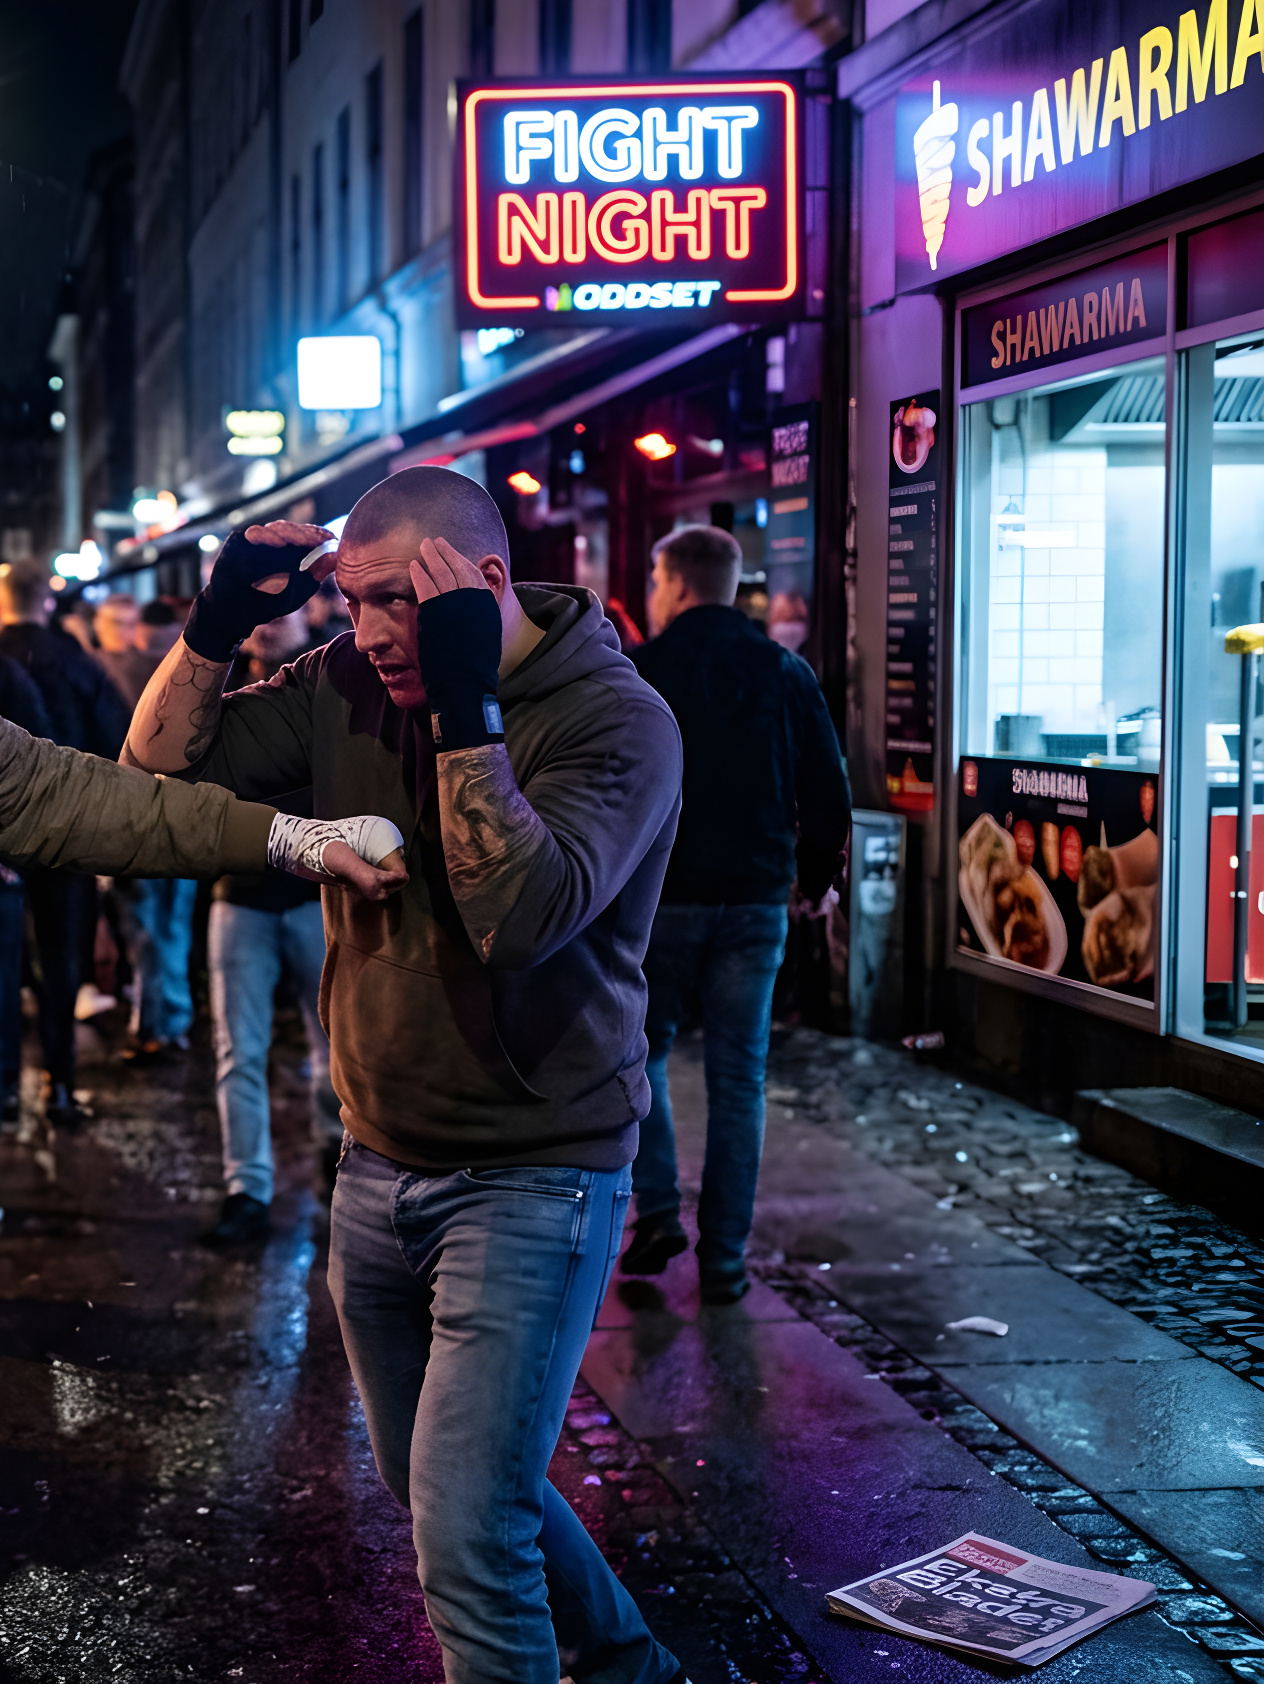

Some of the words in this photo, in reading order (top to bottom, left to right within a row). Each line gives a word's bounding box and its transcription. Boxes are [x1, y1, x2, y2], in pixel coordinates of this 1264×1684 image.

[966, 0, 1264, 208] SHAWARMA
[503, 105, 759, 185] FIGHT
[497, 187, 767, 266] NIGHT
[573, 280, 721, 311] ODDSET
[990, 277, 1148, 370] SHAWARMA
